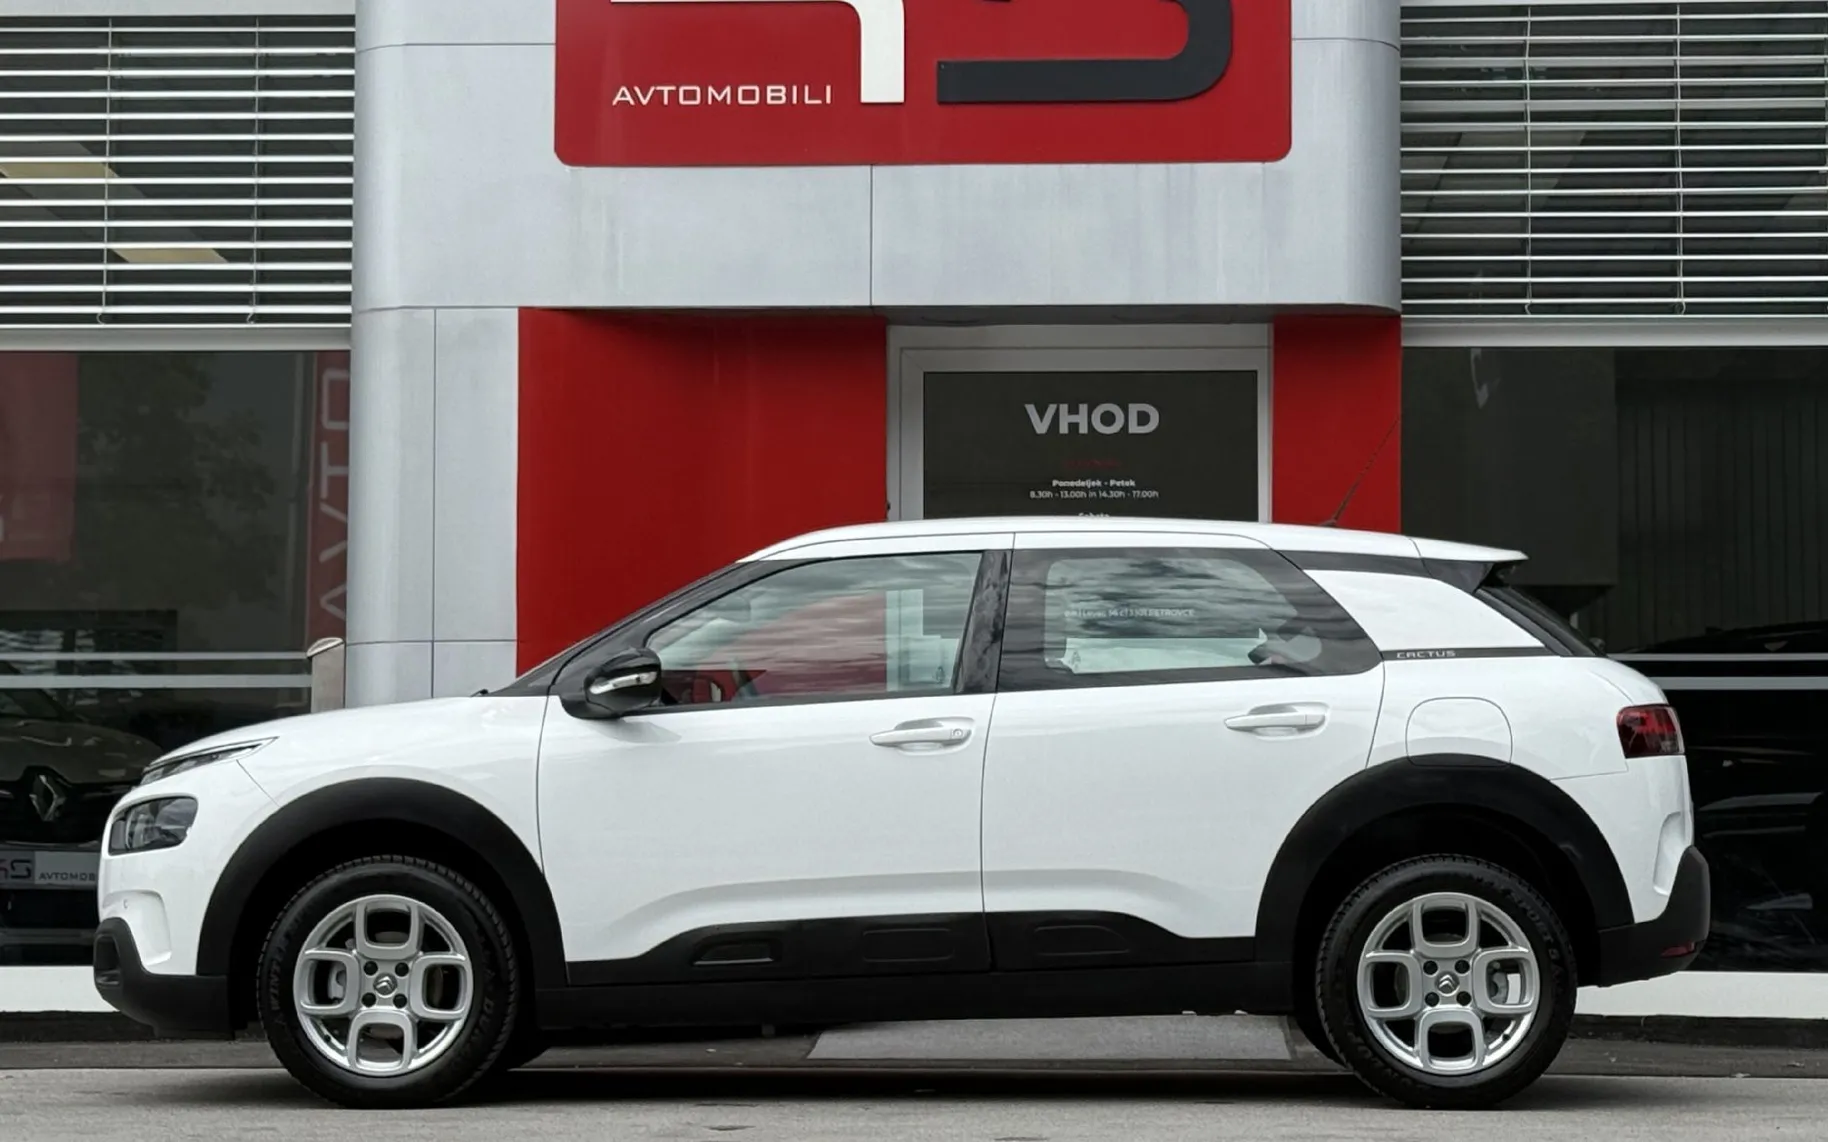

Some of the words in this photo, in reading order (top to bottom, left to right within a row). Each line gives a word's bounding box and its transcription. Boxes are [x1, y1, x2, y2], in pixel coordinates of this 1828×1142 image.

[613, 85, 832, 106] AVTOMOBILI
[1024, 403, 1160, 434] VHOD
[1052, 479, 1102, 488] Ponedeljek
[1089, 490, 1097, 498] in
[1396, 649, 1456, 659] CACTUS
